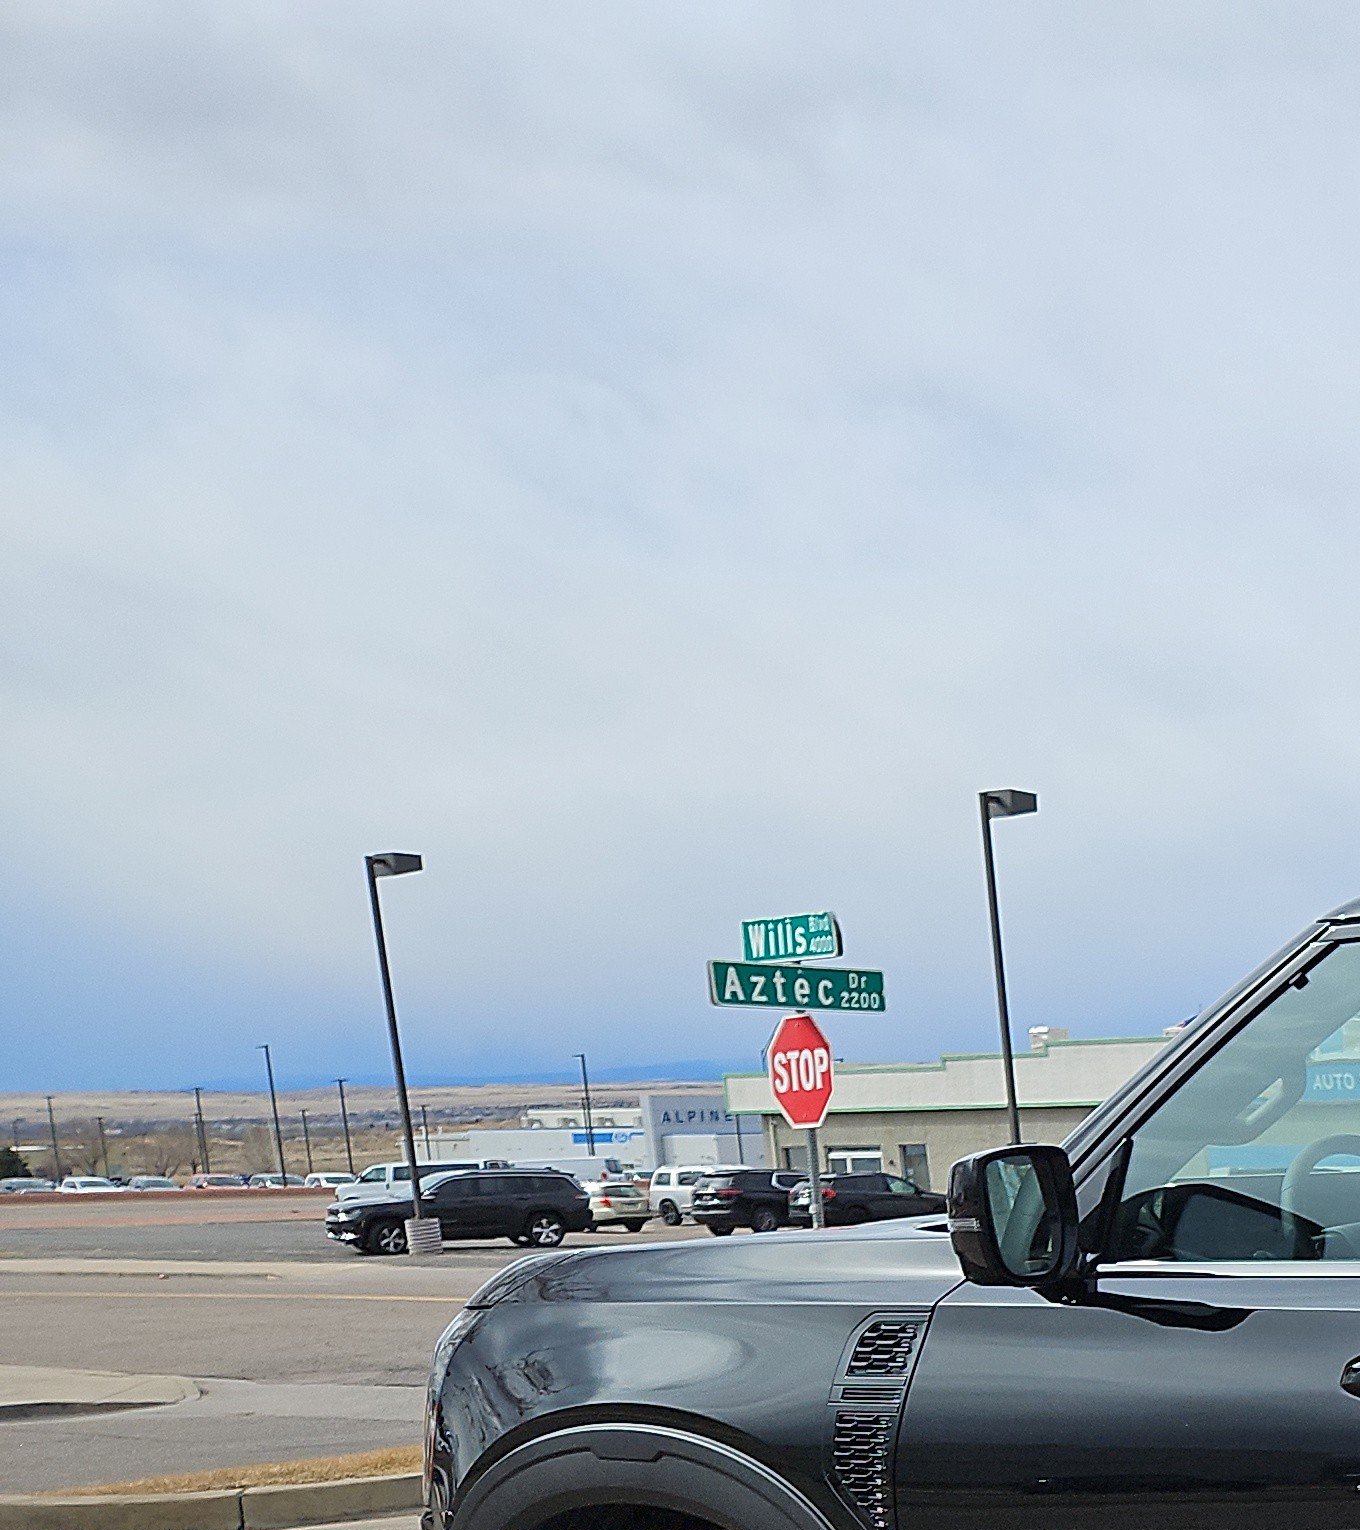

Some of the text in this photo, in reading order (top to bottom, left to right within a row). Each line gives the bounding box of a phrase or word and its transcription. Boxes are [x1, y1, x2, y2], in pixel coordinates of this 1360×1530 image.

[747, 920, 807, 958] Wills
[724, 966, 867, 1005] Aztec Dr
[840, 991, 880, 1009] 2200
[773, 1047, 829, 1094] STOP
[1313, 1072, 1355, 1090] AUTO
